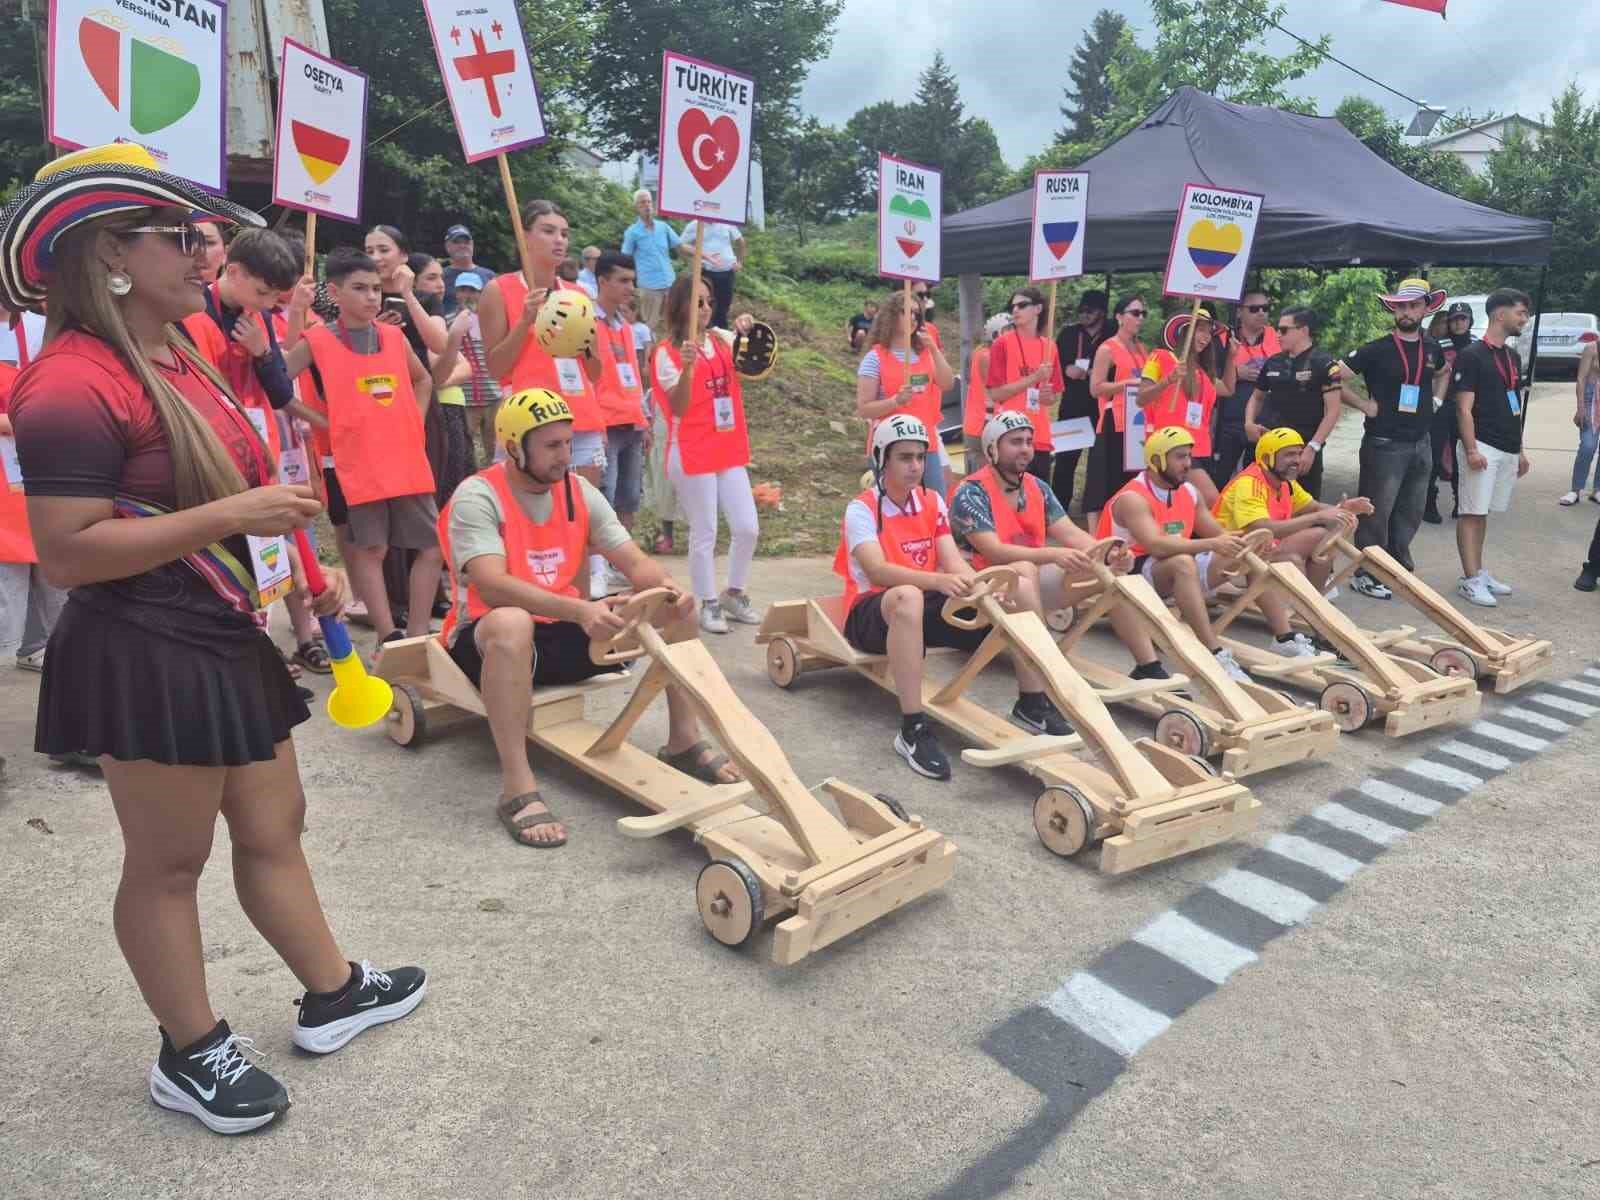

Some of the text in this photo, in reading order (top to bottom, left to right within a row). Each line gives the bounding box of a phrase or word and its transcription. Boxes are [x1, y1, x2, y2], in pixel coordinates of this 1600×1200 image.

[304, 63, 344, 92] OSETYA
[675, 63, 748, 106] TÜRKİYE
[896, 164, 925, 190] İRAN
[1046, 177, 1080, 193] RUSYA
[1191, 191, 1253, 211] KOLOMBİYA
